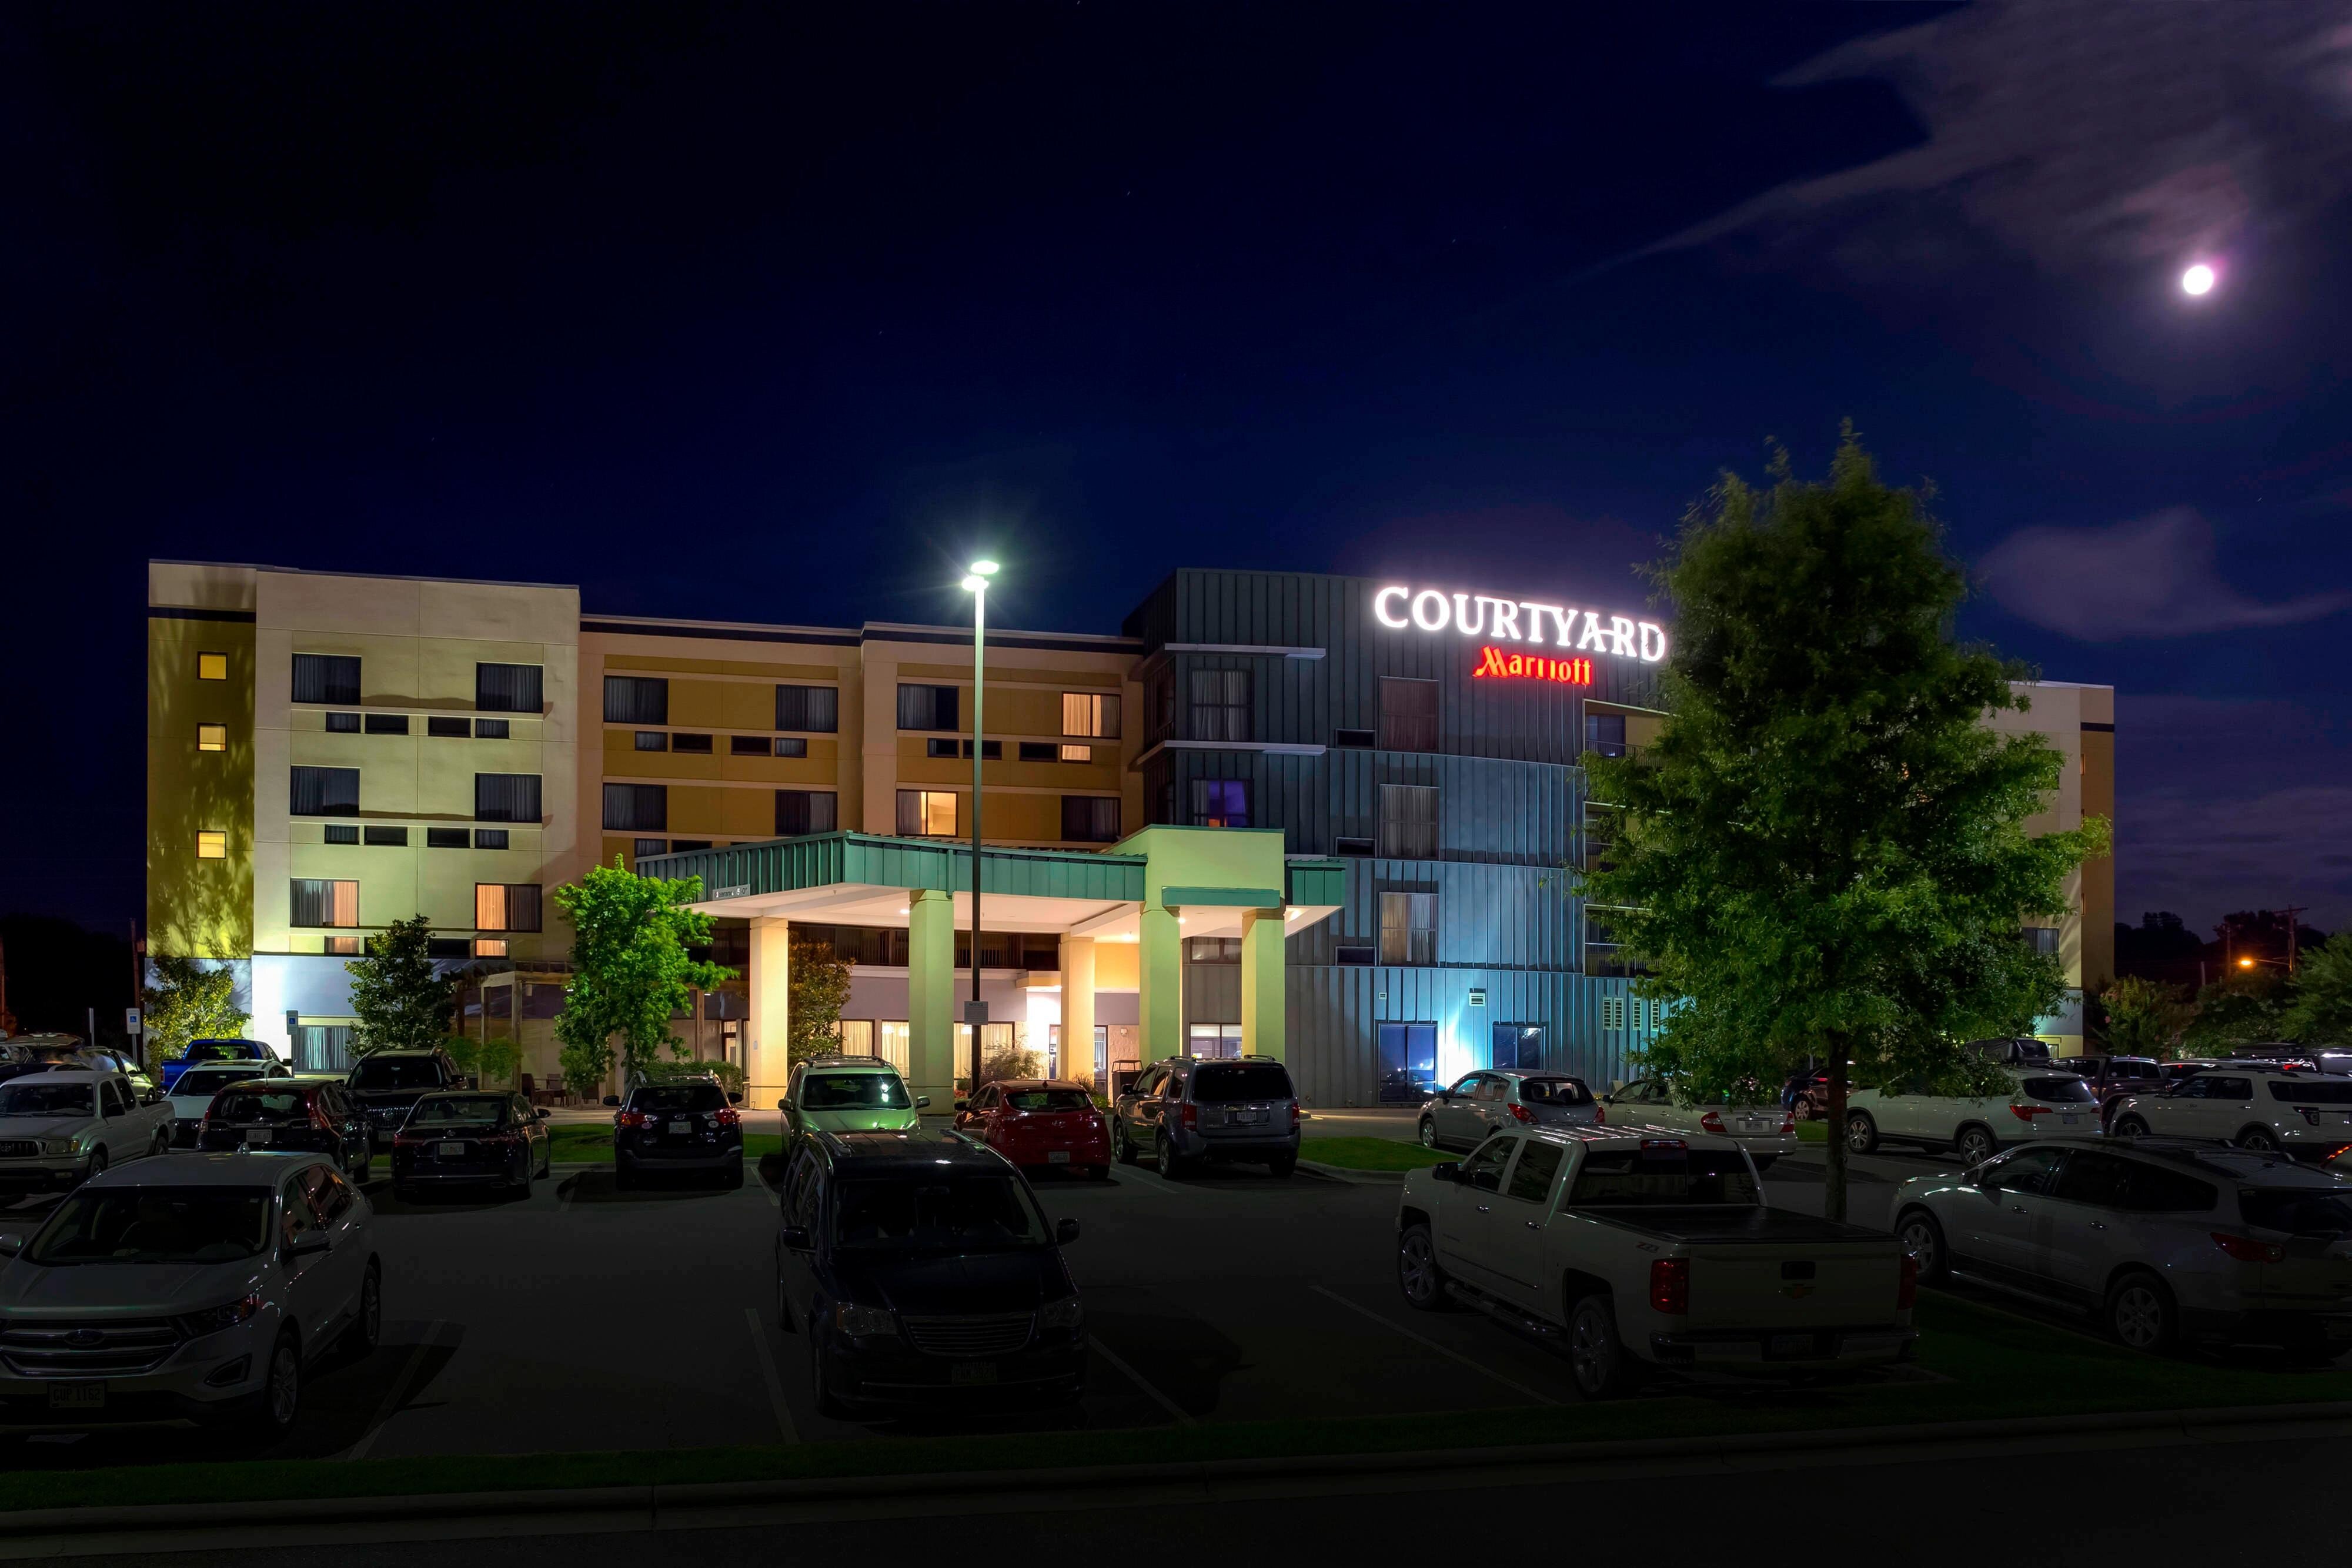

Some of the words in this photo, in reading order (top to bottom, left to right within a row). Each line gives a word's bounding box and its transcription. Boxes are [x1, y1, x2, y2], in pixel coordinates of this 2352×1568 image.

[1374, 586, 1666, 663] COURTYARD
[1472, 645, 1593, 687] Marriott
[75, 1388, 101, 1400] 1162
